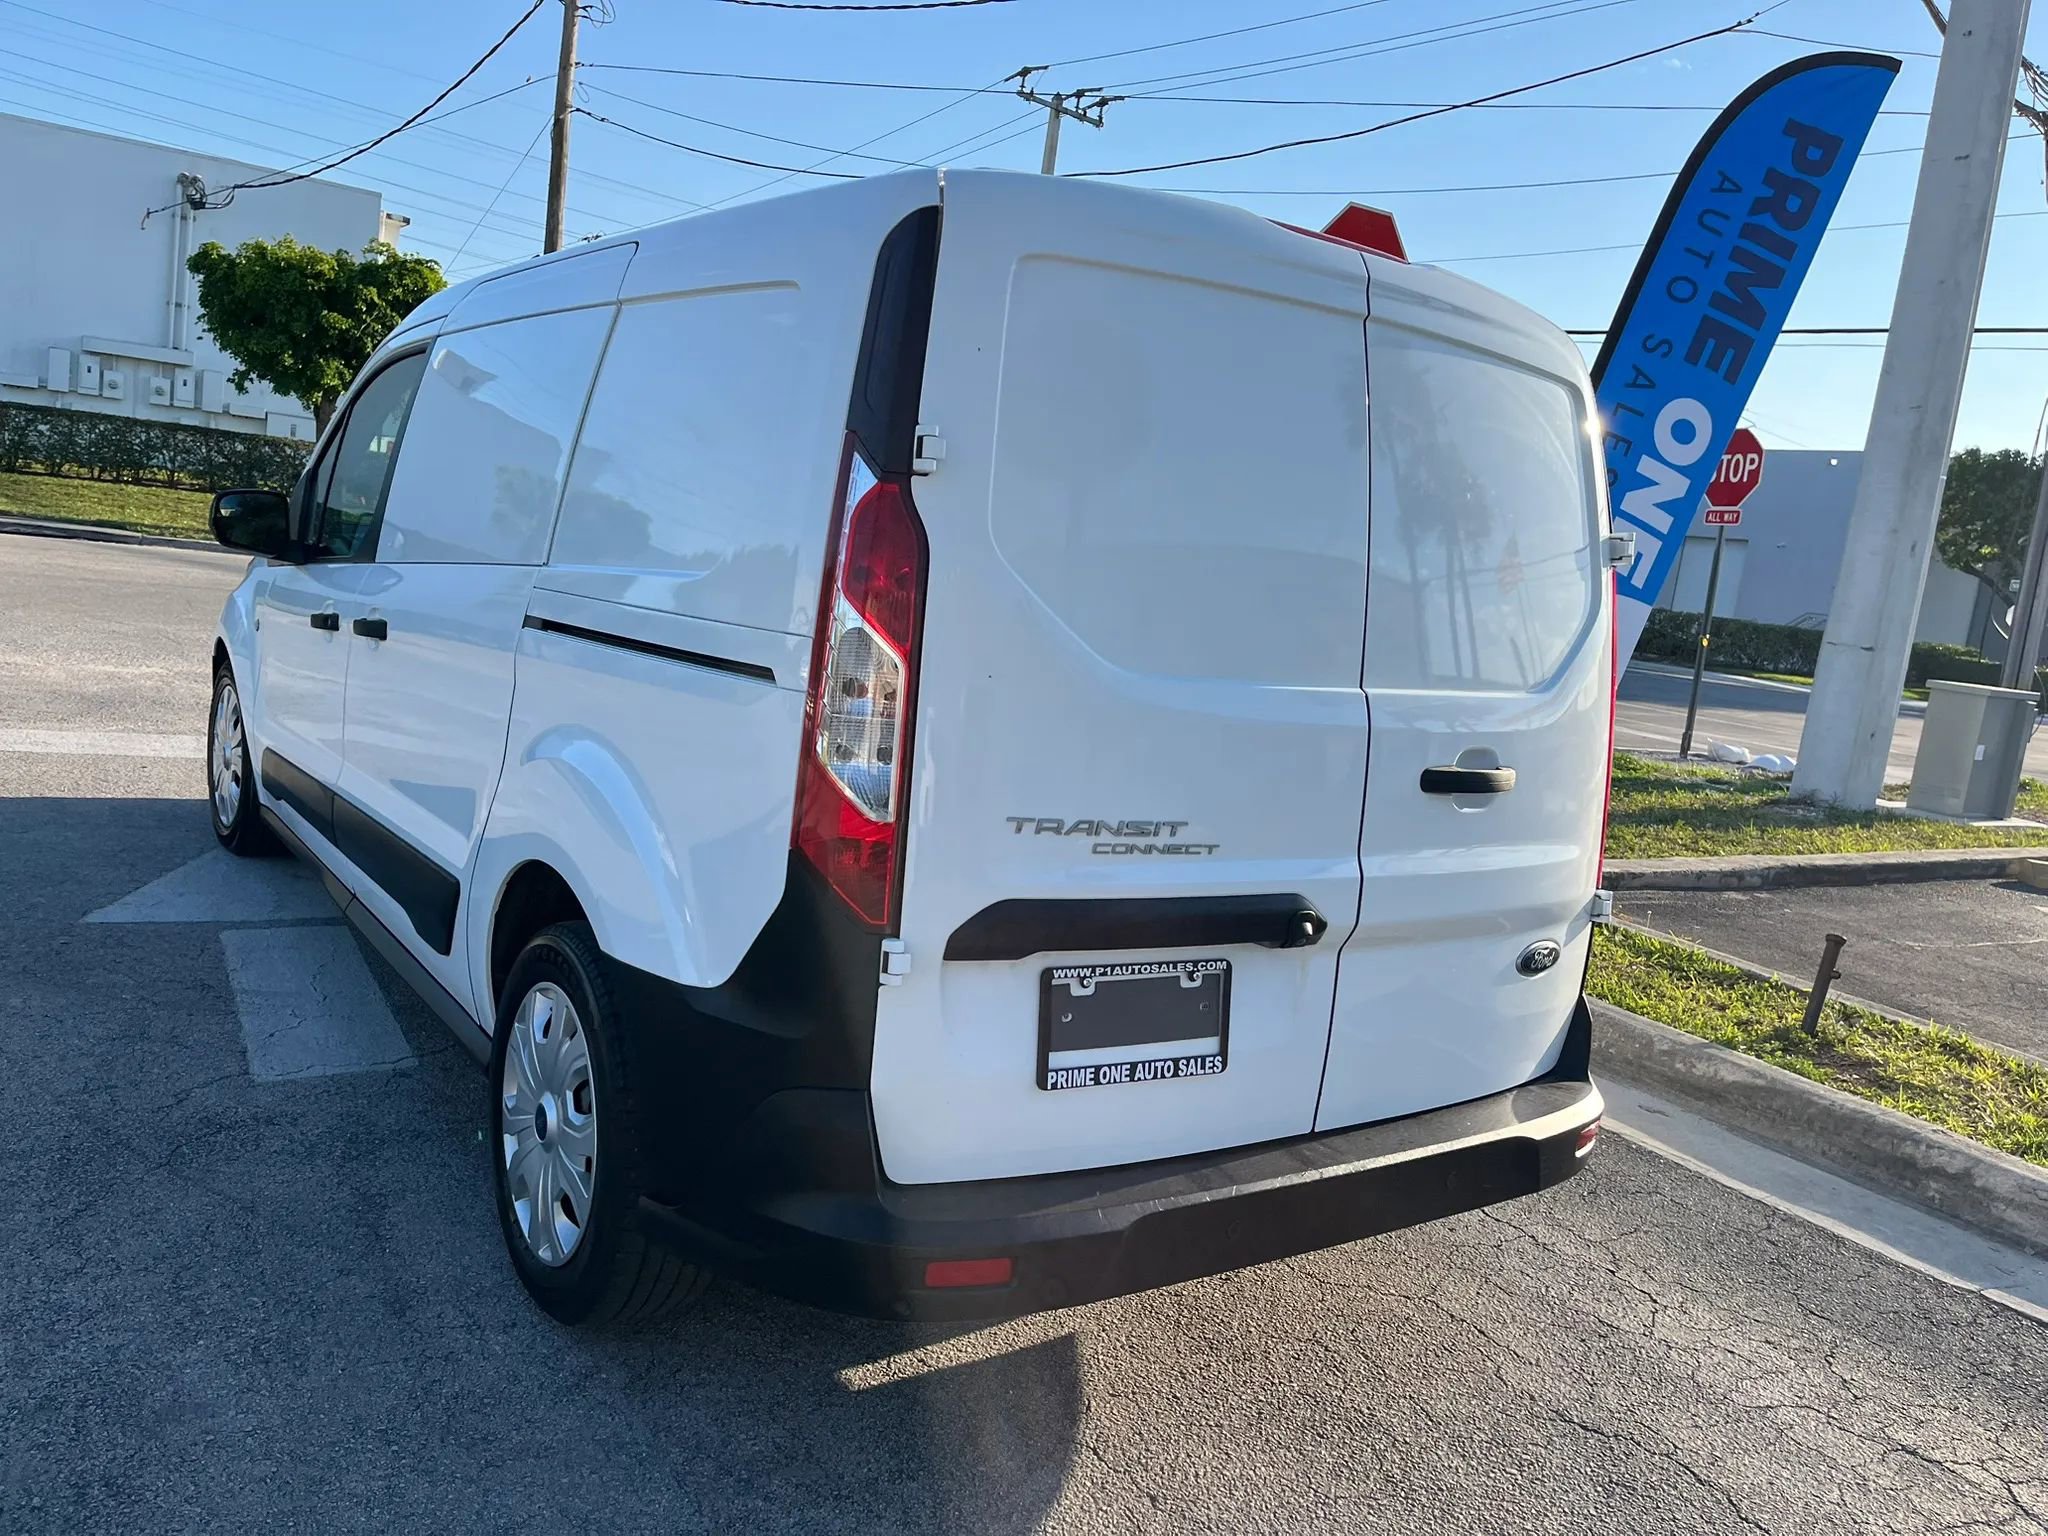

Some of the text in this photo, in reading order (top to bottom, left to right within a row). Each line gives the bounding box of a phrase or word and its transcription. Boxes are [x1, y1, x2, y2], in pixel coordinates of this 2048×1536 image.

[1665, 169, 1743, 304] AUTO
[1614, 118, 1844, 590] PRIME ONE
[1710, 453, 1760, 483] TOP
[1707, 512, 1738, 522] ALL WAY
[1006, 816, 1189, 838] TRANSIT
[1091, 843, 1220, 855] CONNECT
[1053, 960, 1228, 978] WWW.P1AUTOSALES.COM
[1531, 948, 1555, 969] Ford
[1047, 1055, 1224, 1090] PRIME ONE AUTO SALES
